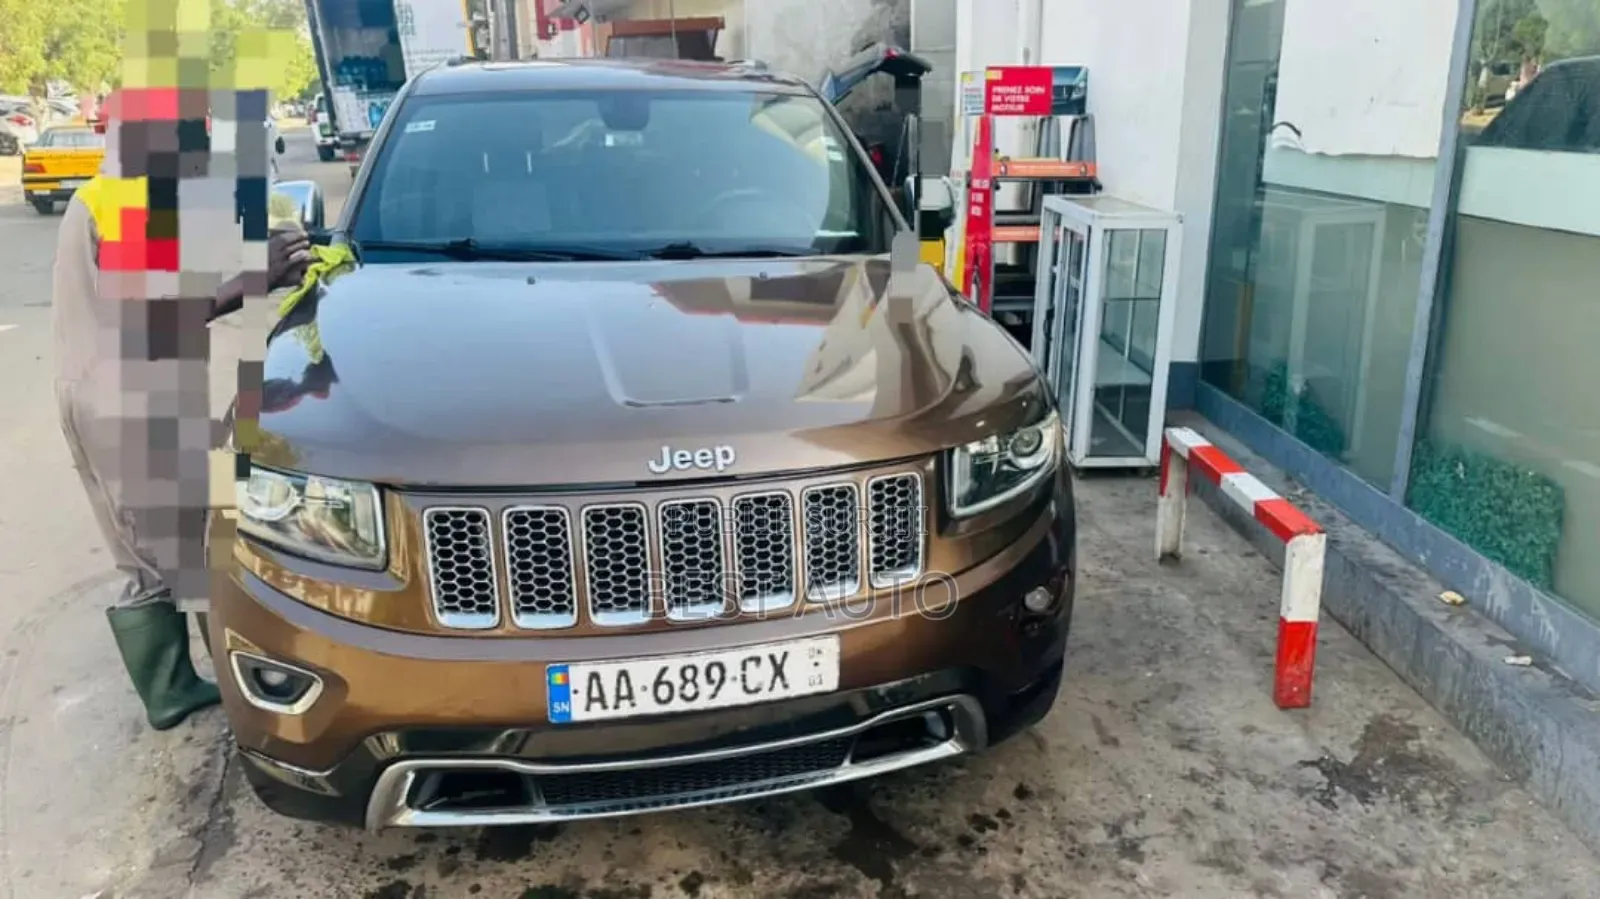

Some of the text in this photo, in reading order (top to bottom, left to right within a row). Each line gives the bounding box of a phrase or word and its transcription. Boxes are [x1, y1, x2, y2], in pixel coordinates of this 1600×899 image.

[992, 86, 1022, 95] PRENEZ
[1024, 86, 1045, 95] SOIN
[992, 94, 1002, 103] DE
[1005, 94, 1030, 103] VOTRE
[991, 103, 1025, 112] MOTEUR
[648, 445, 736, 474] Jeep
[552, 701, 570, 714] SN
